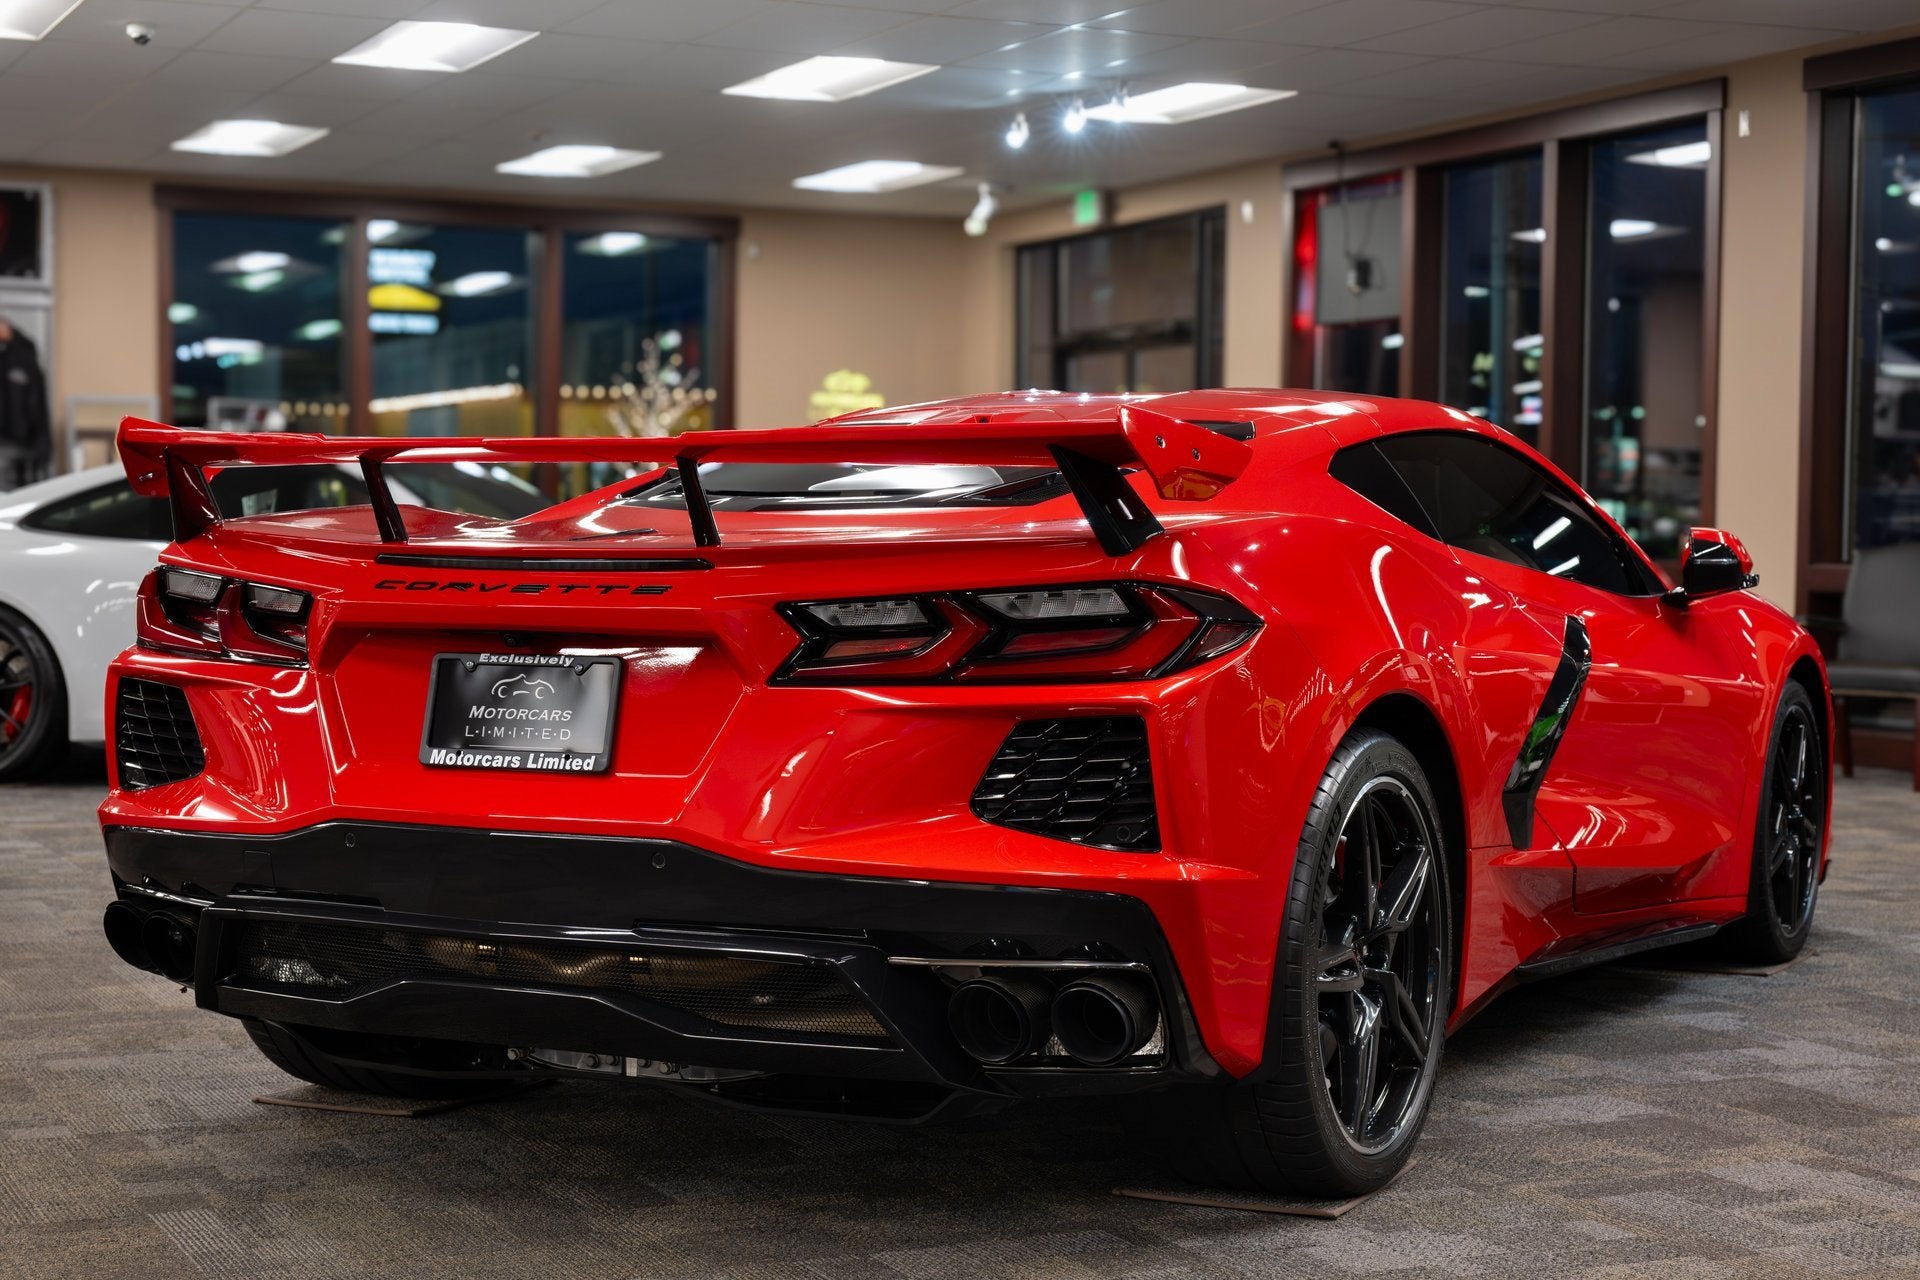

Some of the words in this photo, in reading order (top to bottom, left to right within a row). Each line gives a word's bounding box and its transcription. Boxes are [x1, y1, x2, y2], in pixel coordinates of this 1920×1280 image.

[374, 580, 673, 595] CORVETTE
[478, 653, 575, 667] Exclusively
[429, 749, 521, 768] Motorcars
[526, 753, 596, 771] Limited
